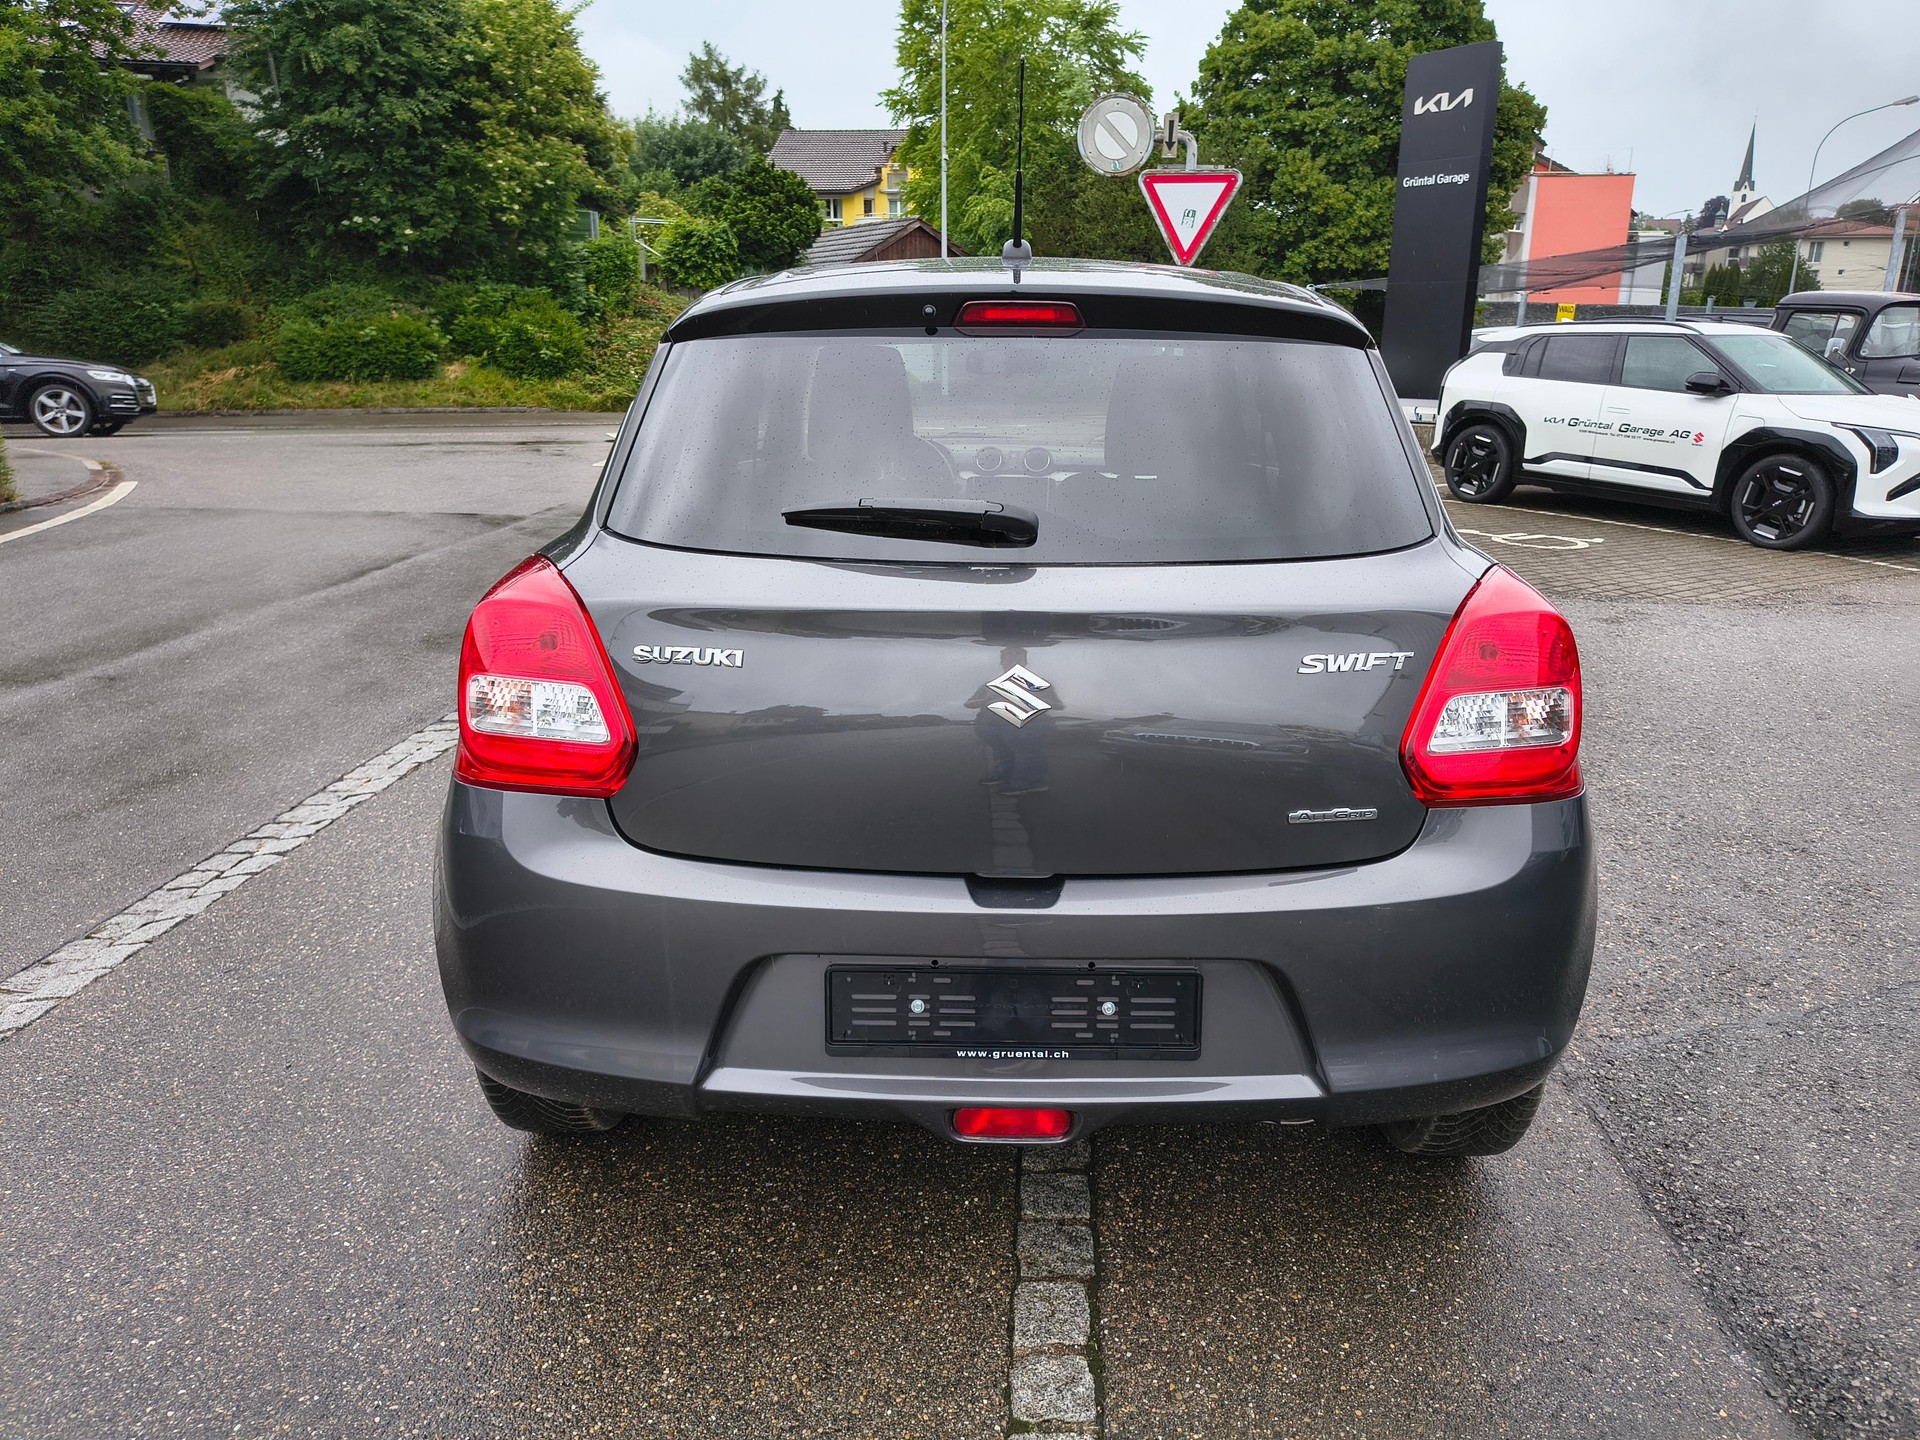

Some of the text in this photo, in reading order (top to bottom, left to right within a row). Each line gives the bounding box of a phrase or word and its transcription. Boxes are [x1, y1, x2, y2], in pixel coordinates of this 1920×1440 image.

[1414, 88, 1474, 115] KIA
[1403, 172, 1470, 188] Grüntal Garage
[1567, 417, 1614, 430] Grüntal
[1618, 423, 1665, 437] Garage
[1669, 429, 1692, 439] AG
[632, 644, 744, 668] SUZUKI
[1297, 651, 1415, 674] SWIFT
[956, 1050, 1070, 1060] www.gruental.ch
